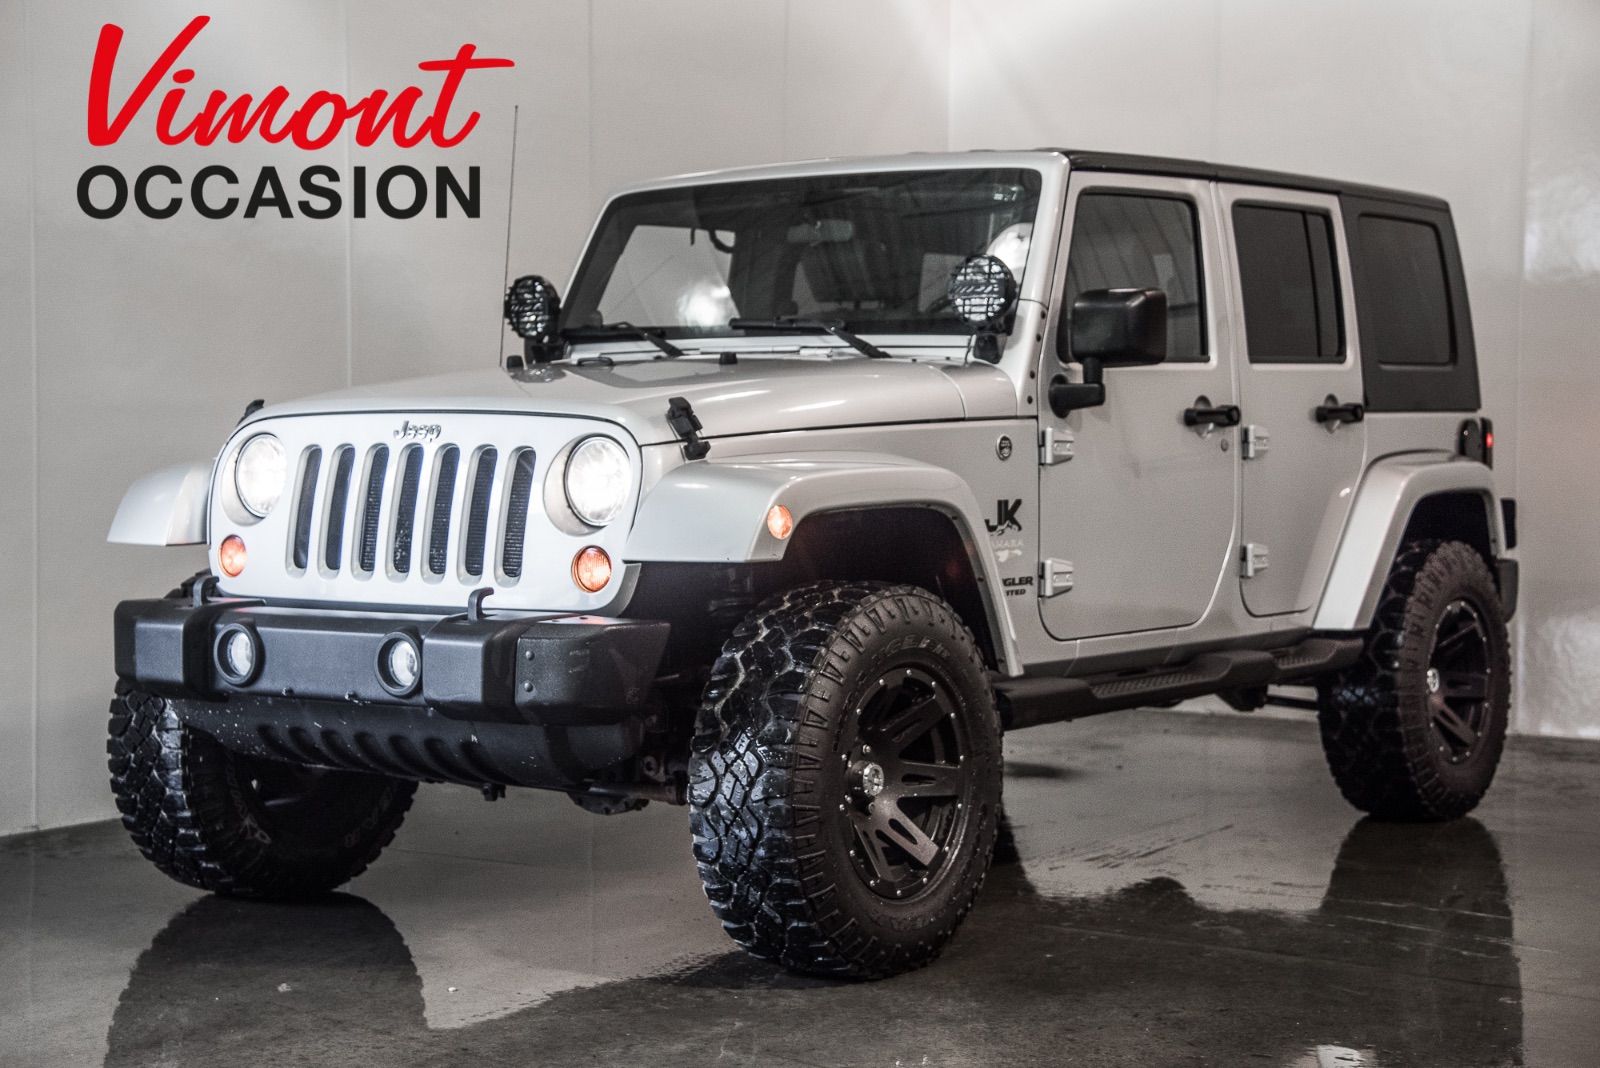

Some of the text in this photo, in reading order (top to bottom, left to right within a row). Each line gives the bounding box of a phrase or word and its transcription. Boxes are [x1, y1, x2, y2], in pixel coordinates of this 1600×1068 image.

[393, 420, 441, 442] Jeep
[984, 499, 1022, 533] JK
[1002, 576, 1034, 587] GLER
